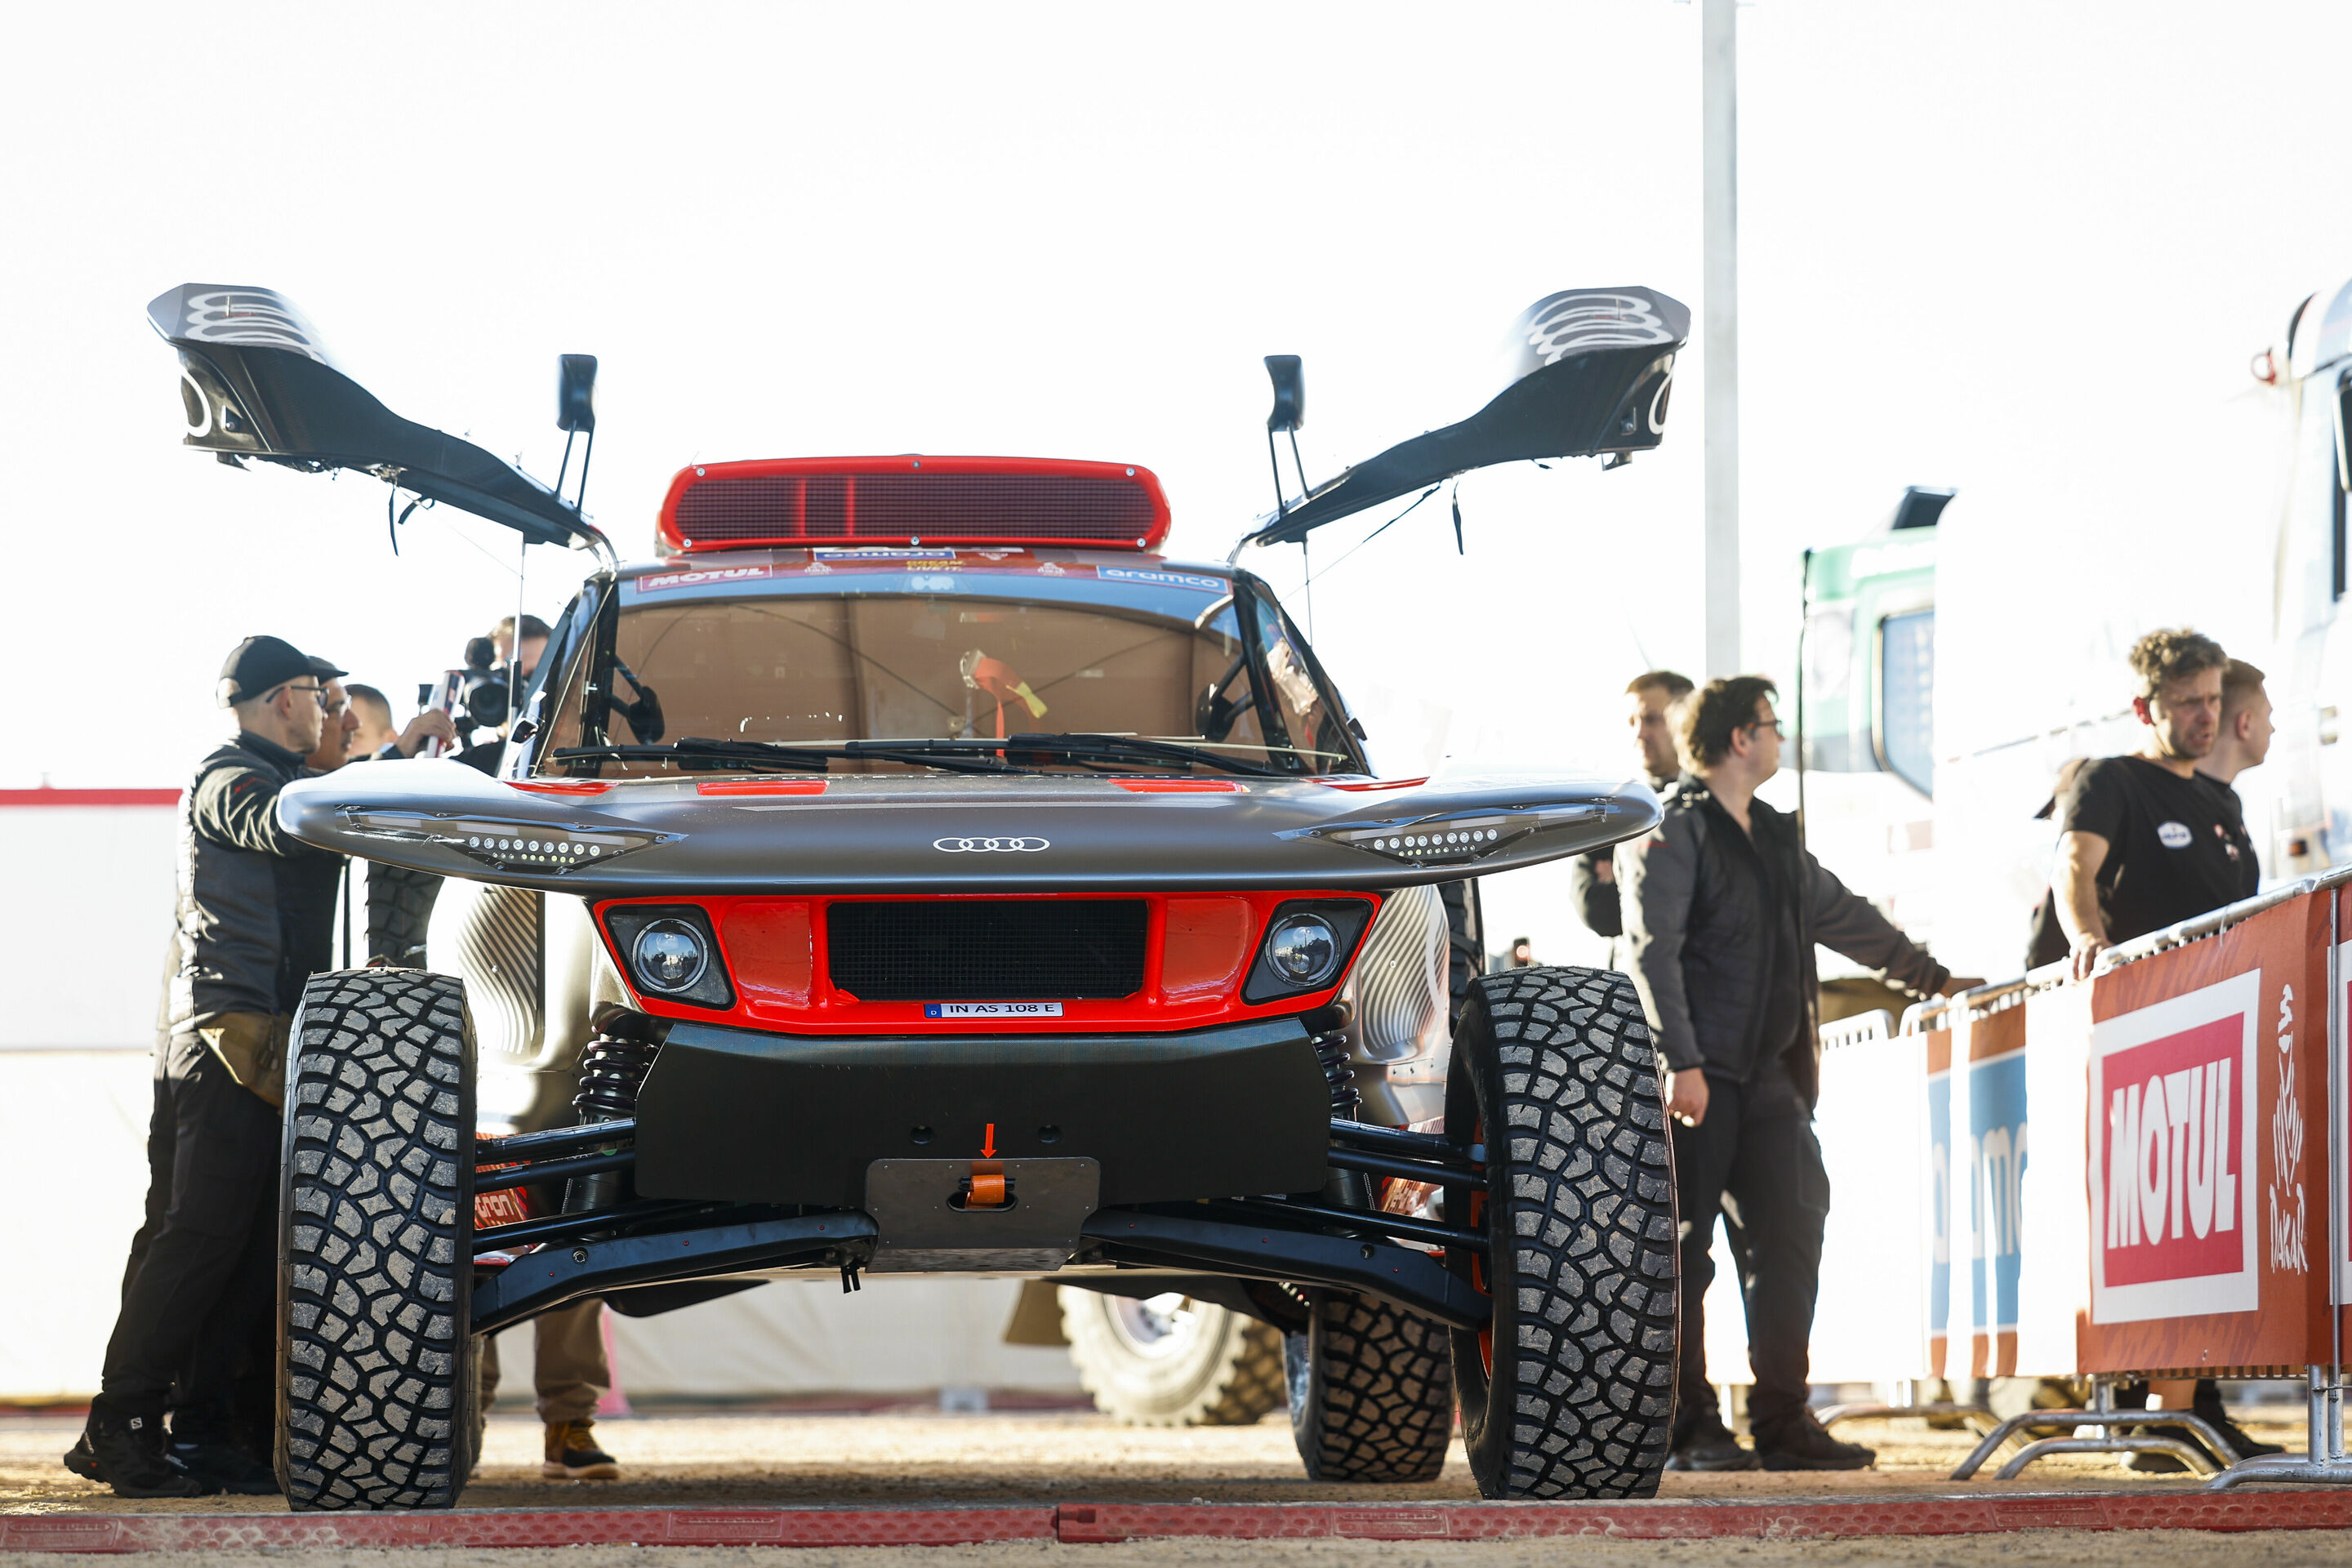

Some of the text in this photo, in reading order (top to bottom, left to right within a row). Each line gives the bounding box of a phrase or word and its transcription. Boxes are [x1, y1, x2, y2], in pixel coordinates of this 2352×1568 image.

[648, 568, 764, 588] MOTUL
[1106, 568, 1219, 588] aramco
[950, 1004, 1055, 1013] IN AS 108 E
[2107, 1057, 2236, 1250] MOTUL
[2270, 1183, 2309, 1276] DAKAR
